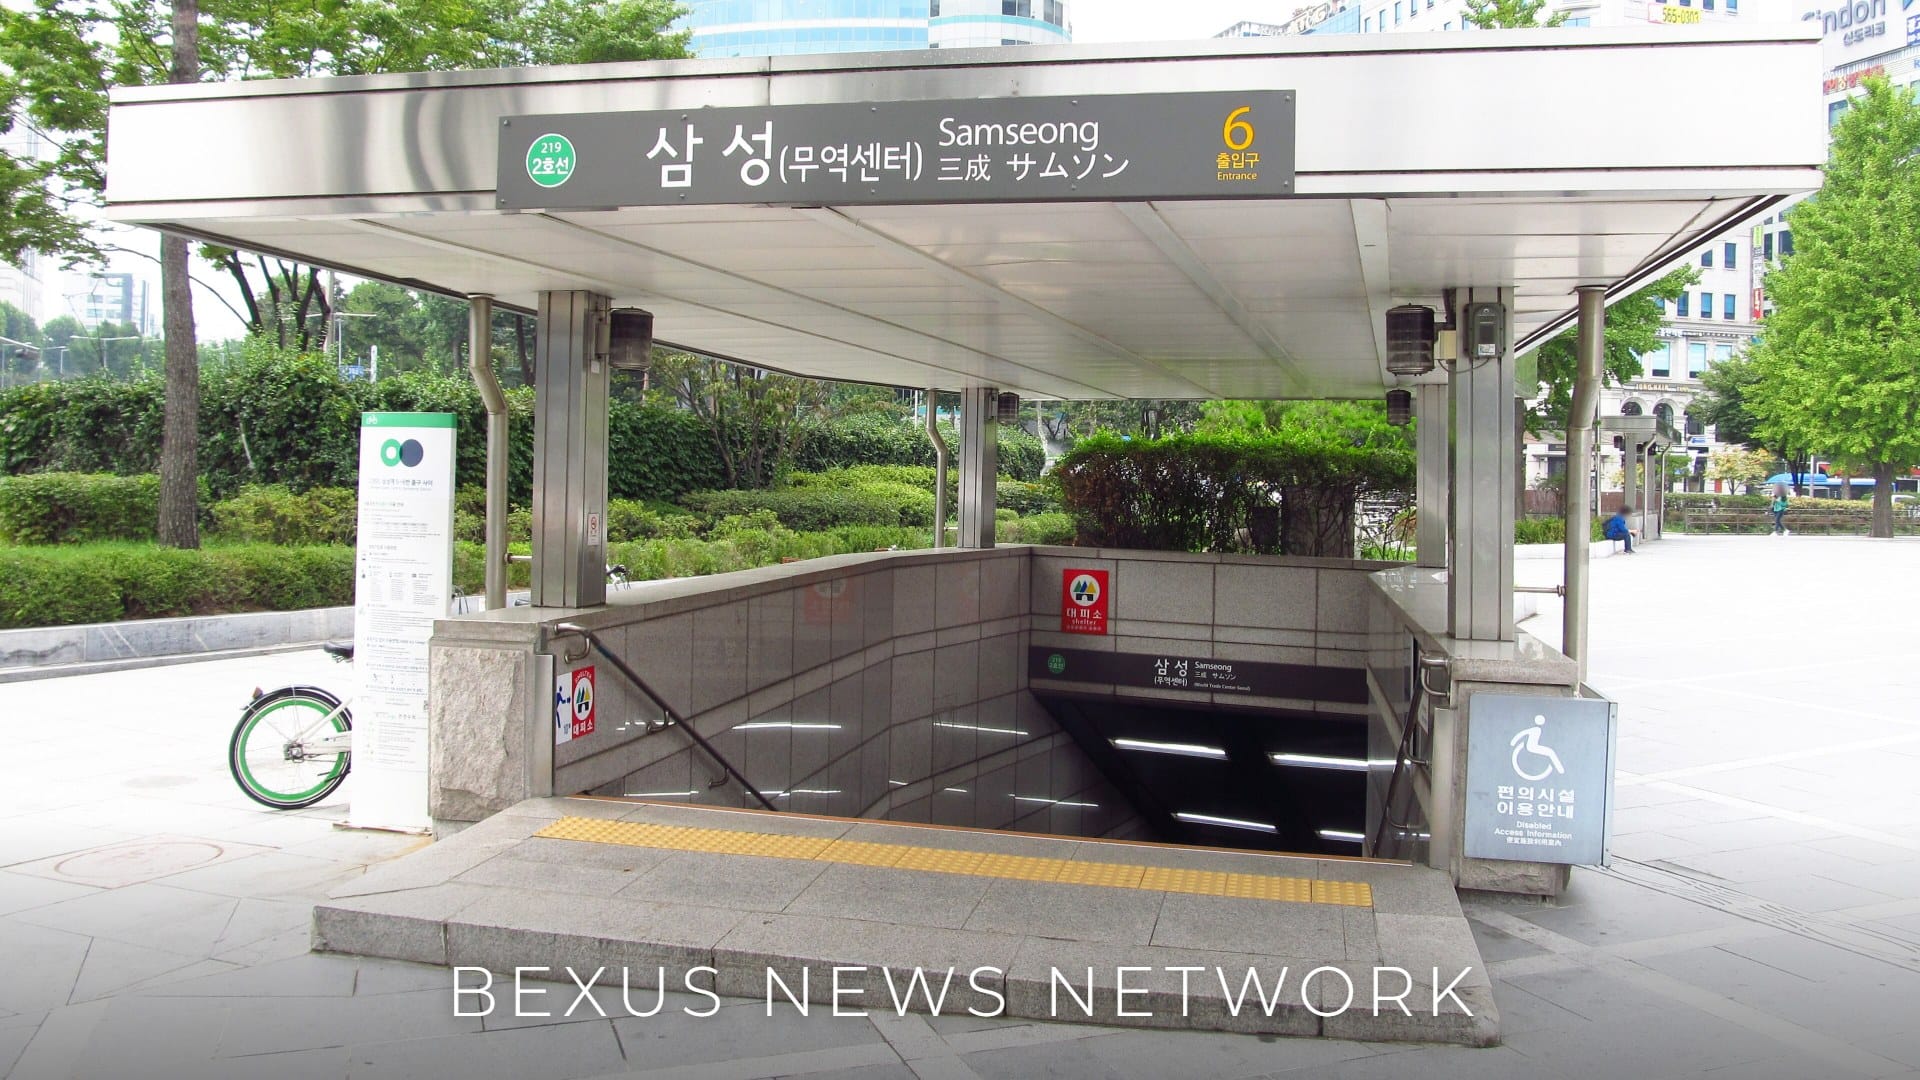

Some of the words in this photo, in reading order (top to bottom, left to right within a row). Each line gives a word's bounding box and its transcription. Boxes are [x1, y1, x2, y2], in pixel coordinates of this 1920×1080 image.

[1843, 20, 1886, 46] 신도리코
[938, 117, 1099, 151] Samseong
[1223, 106, 1254, 150] 6
[541, 142, 562, 153] 219
[532, 156, 569, 175] 2호선
[937, 153, 991, 181] 三成
[1006, 152, 1129, 181] サムソン
[1216, 152, 1260, 169] 출입구
[1217, 172, 1257, 180] Entrance
[1066, 607, 1102, 619] 대피소
[1194, 661, 1232, 673] Samseong
[572, 719, 593, 736] 대피소
[1497, 785, 1575, 803] 편의시설
[1496, 801, 1574, 819] 이용안내
[1494, 827, 1524, 836] Access
[1526, 829, 1573, 840] Information
[1516, 820, 1552, 830] Disabled
